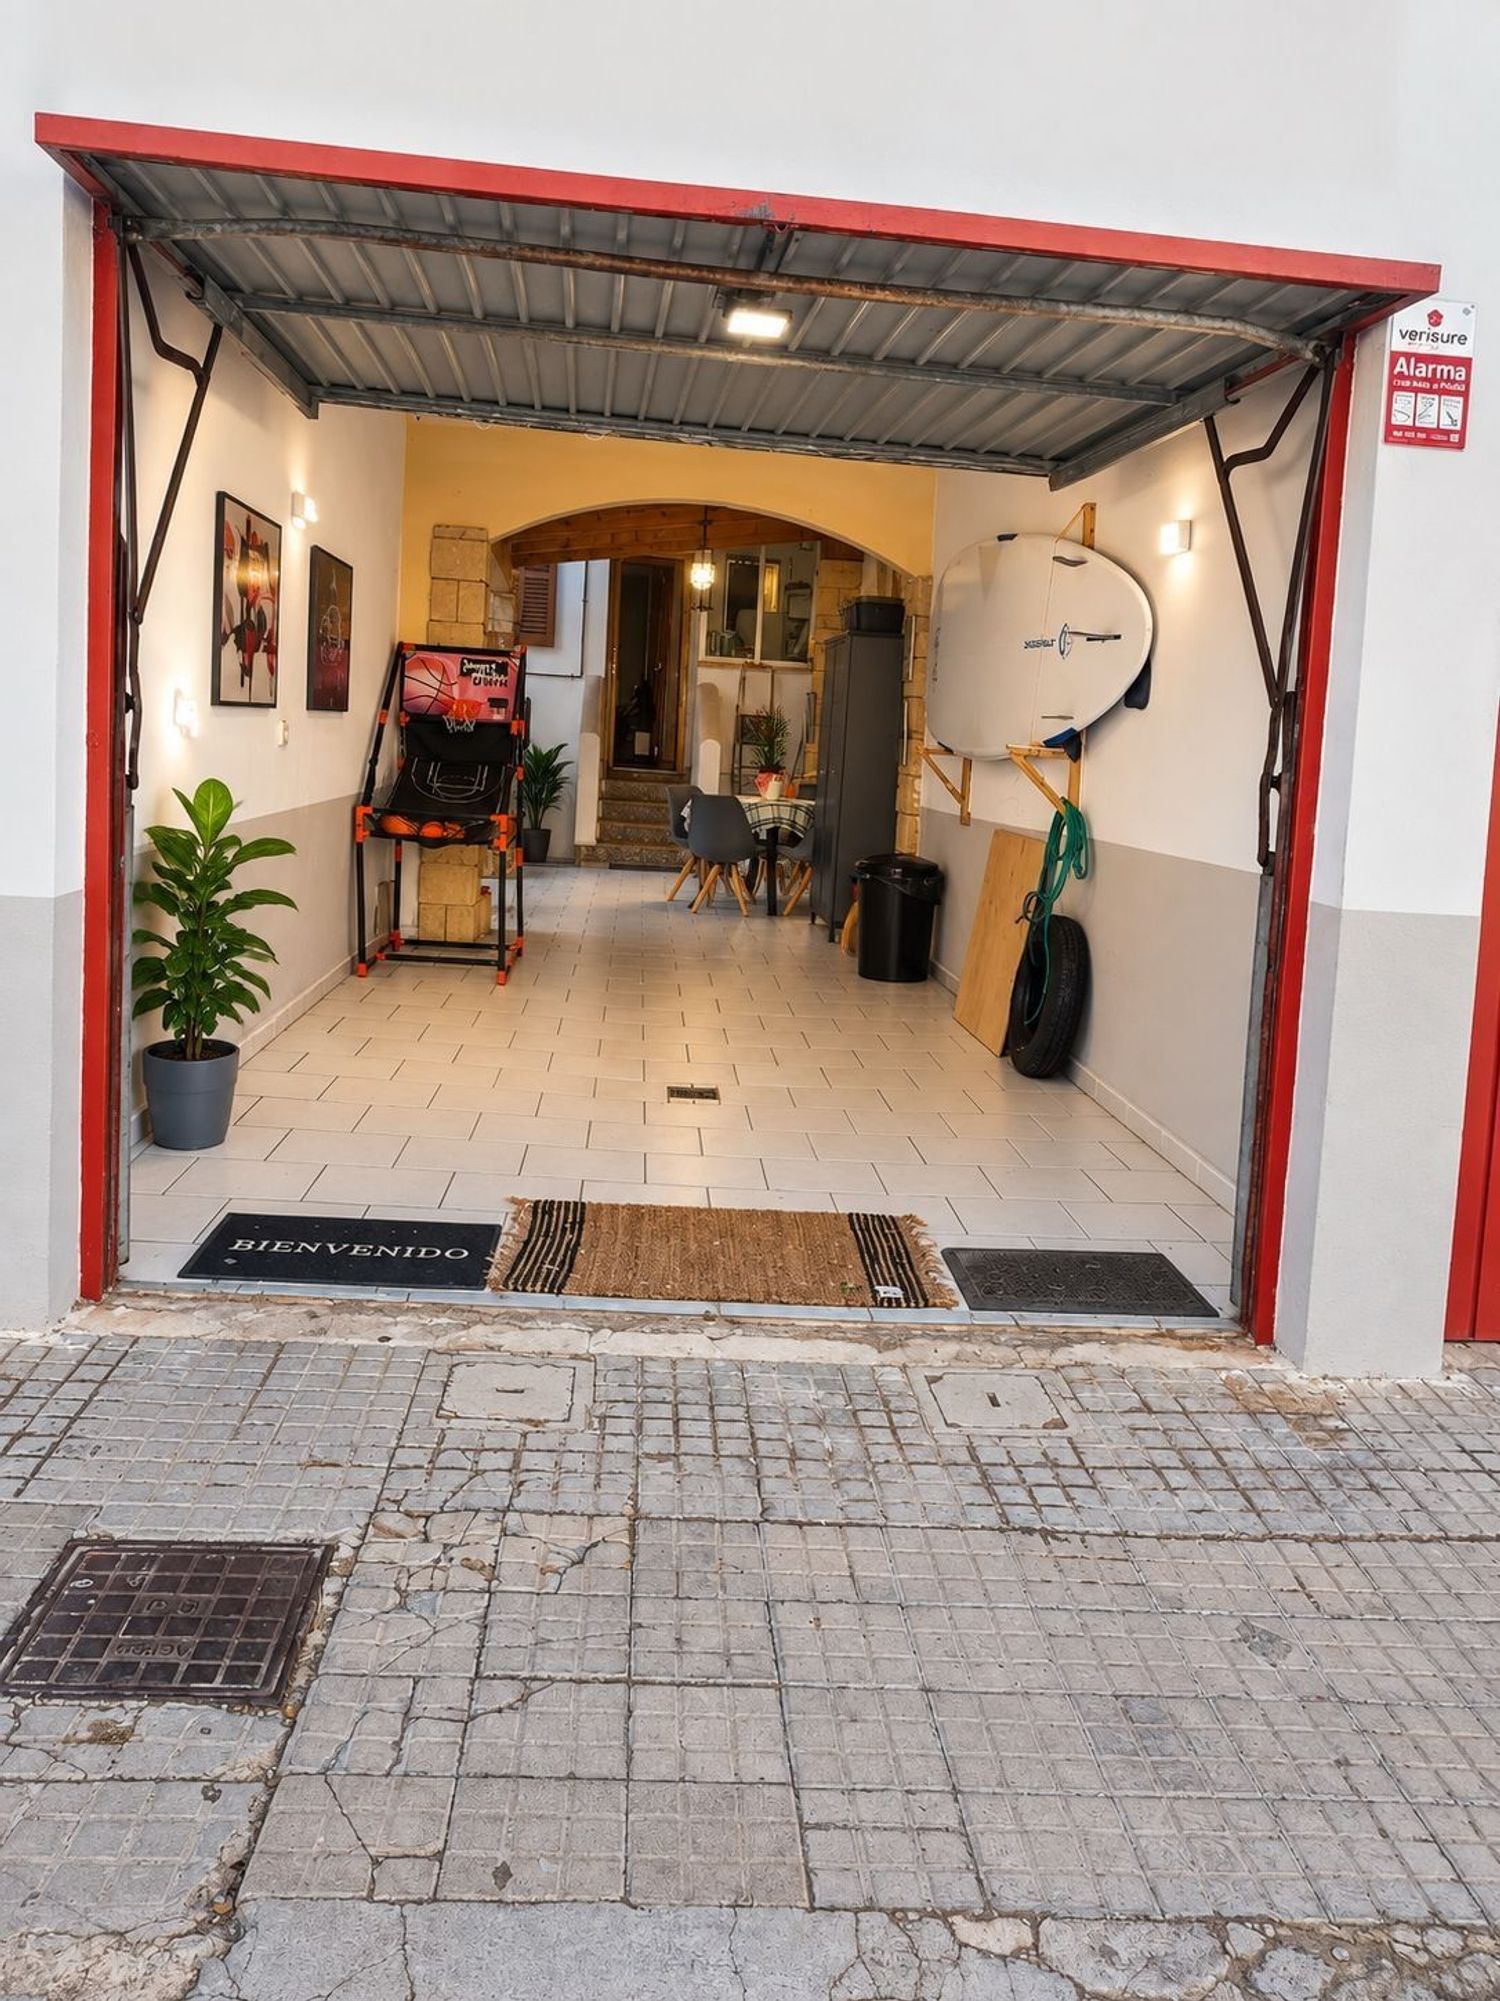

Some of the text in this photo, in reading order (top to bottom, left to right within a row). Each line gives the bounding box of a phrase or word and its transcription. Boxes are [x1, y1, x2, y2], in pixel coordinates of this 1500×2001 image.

[1399, 328, 1468, 345] verisure
[1393, 357, 1467, 381] Alarma
[229, 1239, 469, 1260] BIENVENIDO
